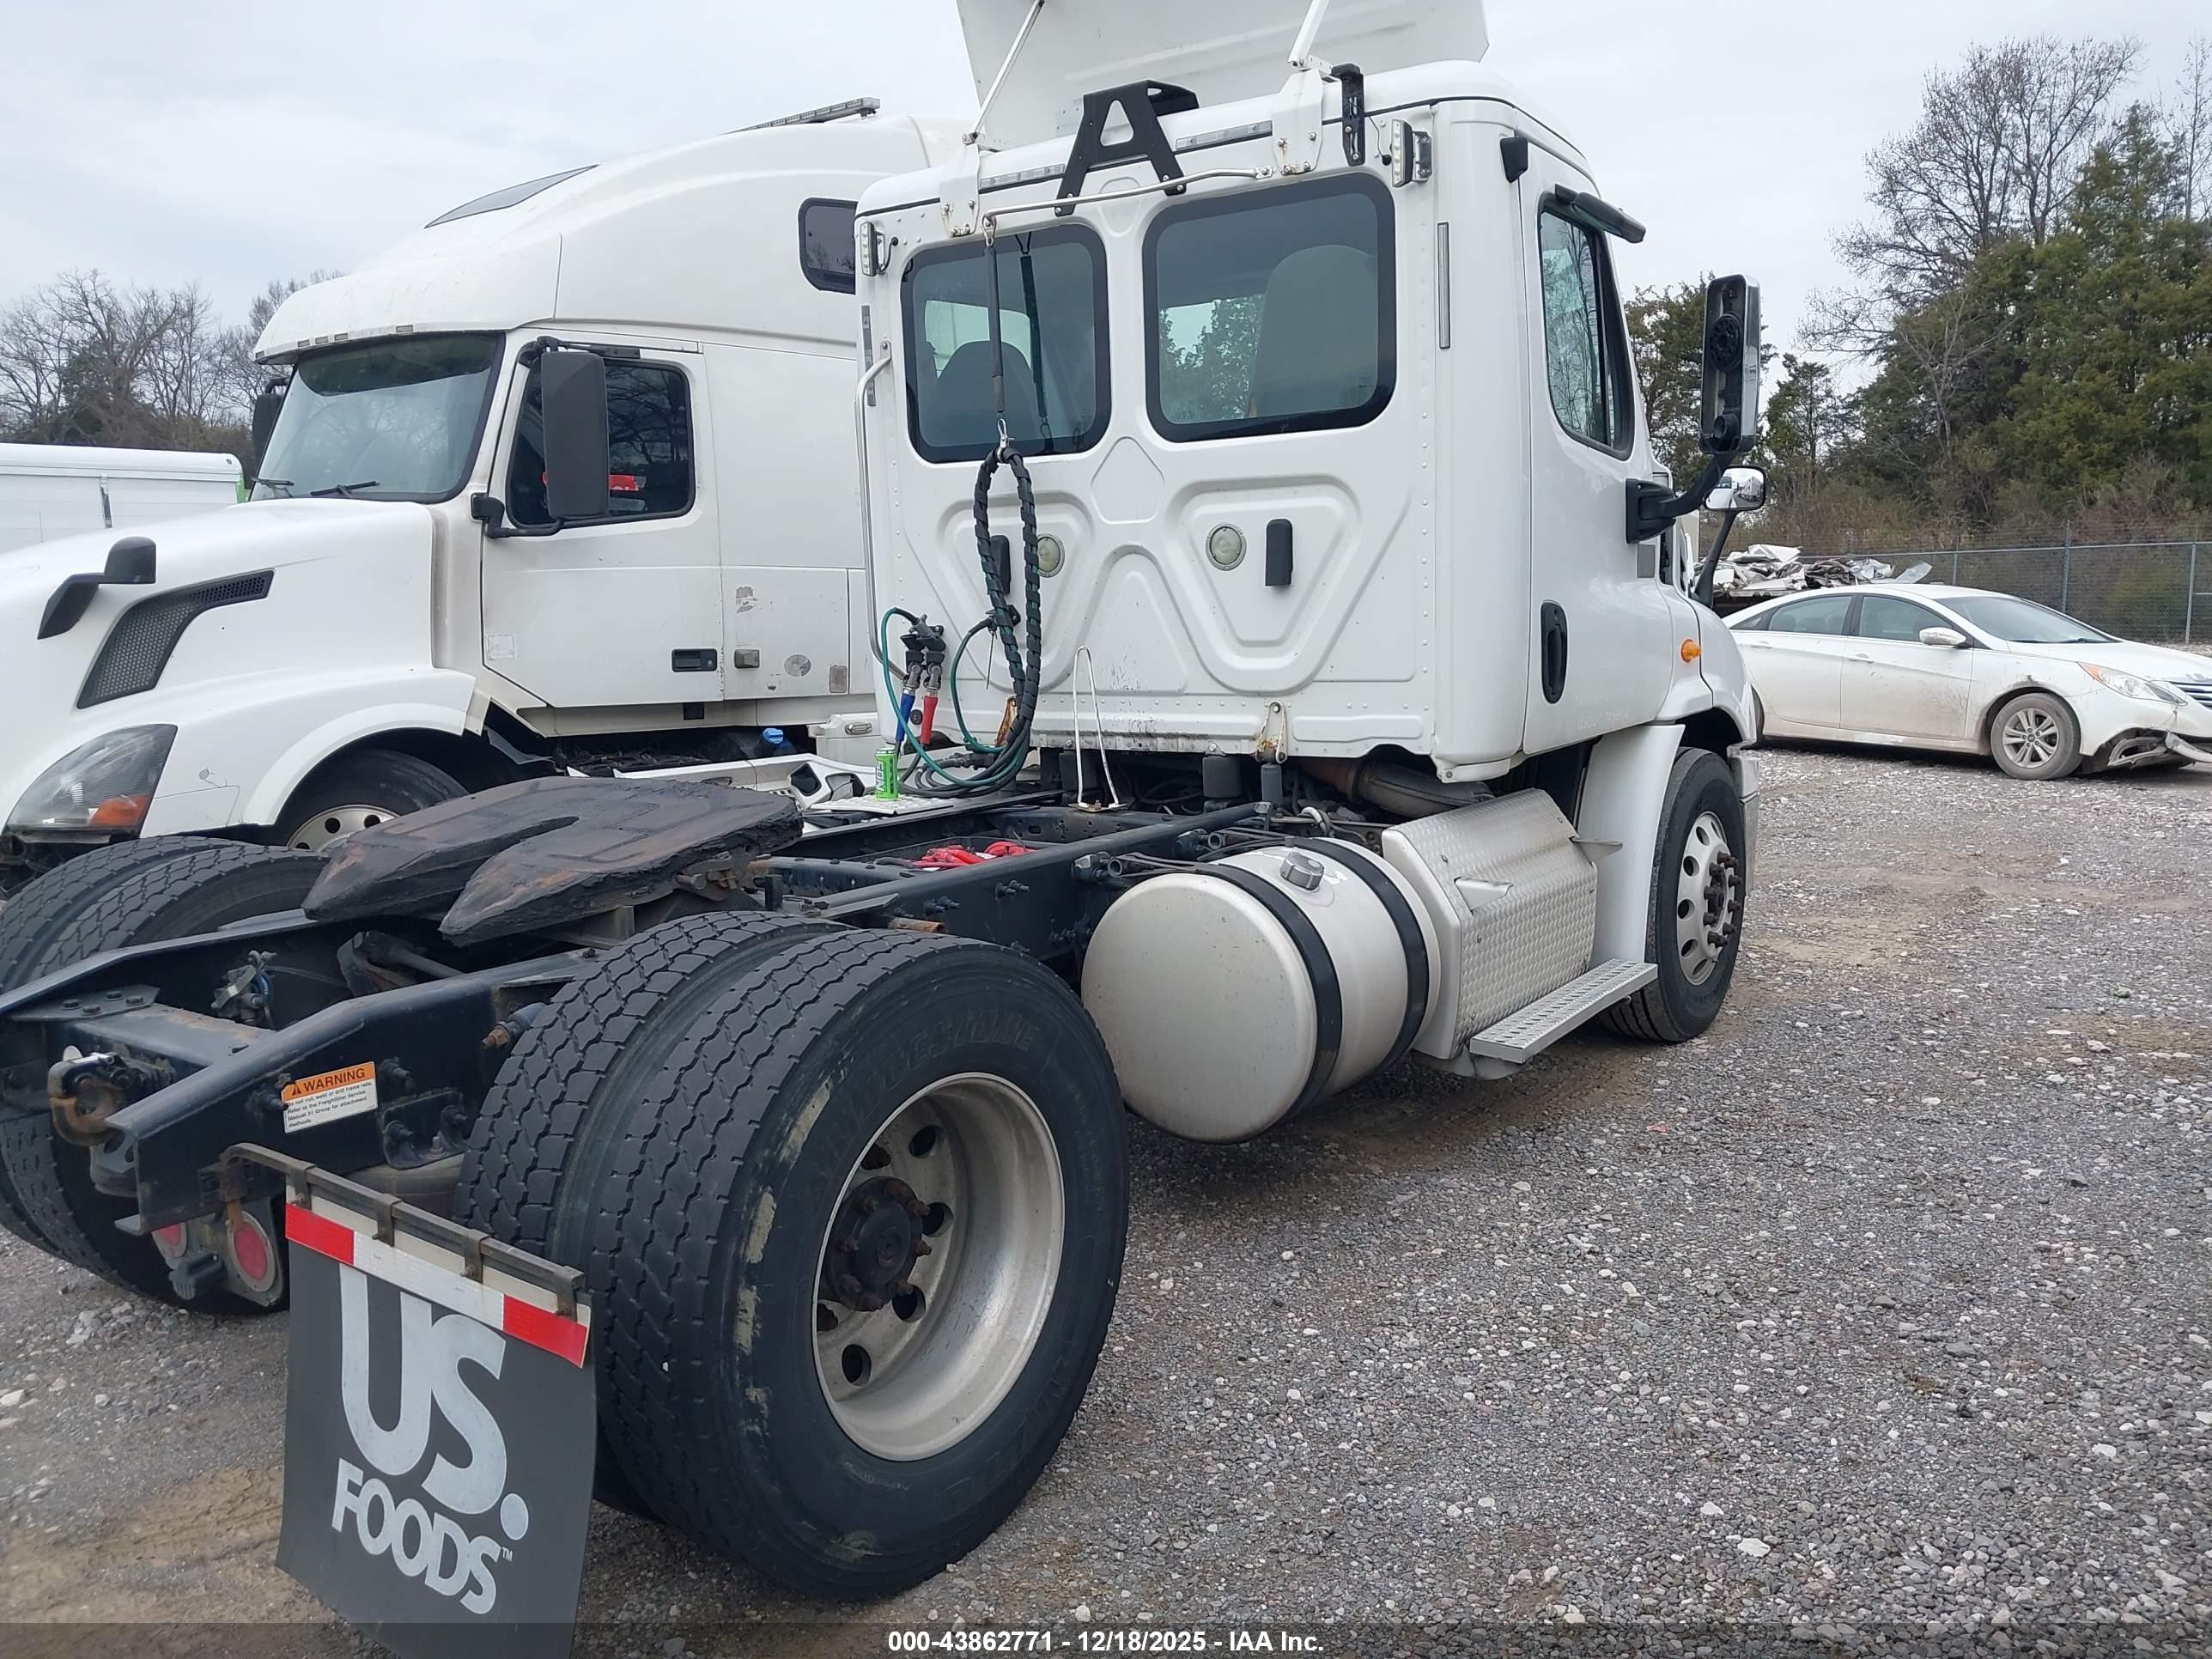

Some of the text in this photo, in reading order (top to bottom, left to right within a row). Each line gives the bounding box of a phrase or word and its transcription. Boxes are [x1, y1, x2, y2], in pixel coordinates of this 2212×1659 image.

[875, 761, 885, 793] NOS
[304, 1068, 365, 1091] WARNING
[340, 1097, 367, 1107] attachment
[331, 1457, 501, 1614] FOODS
